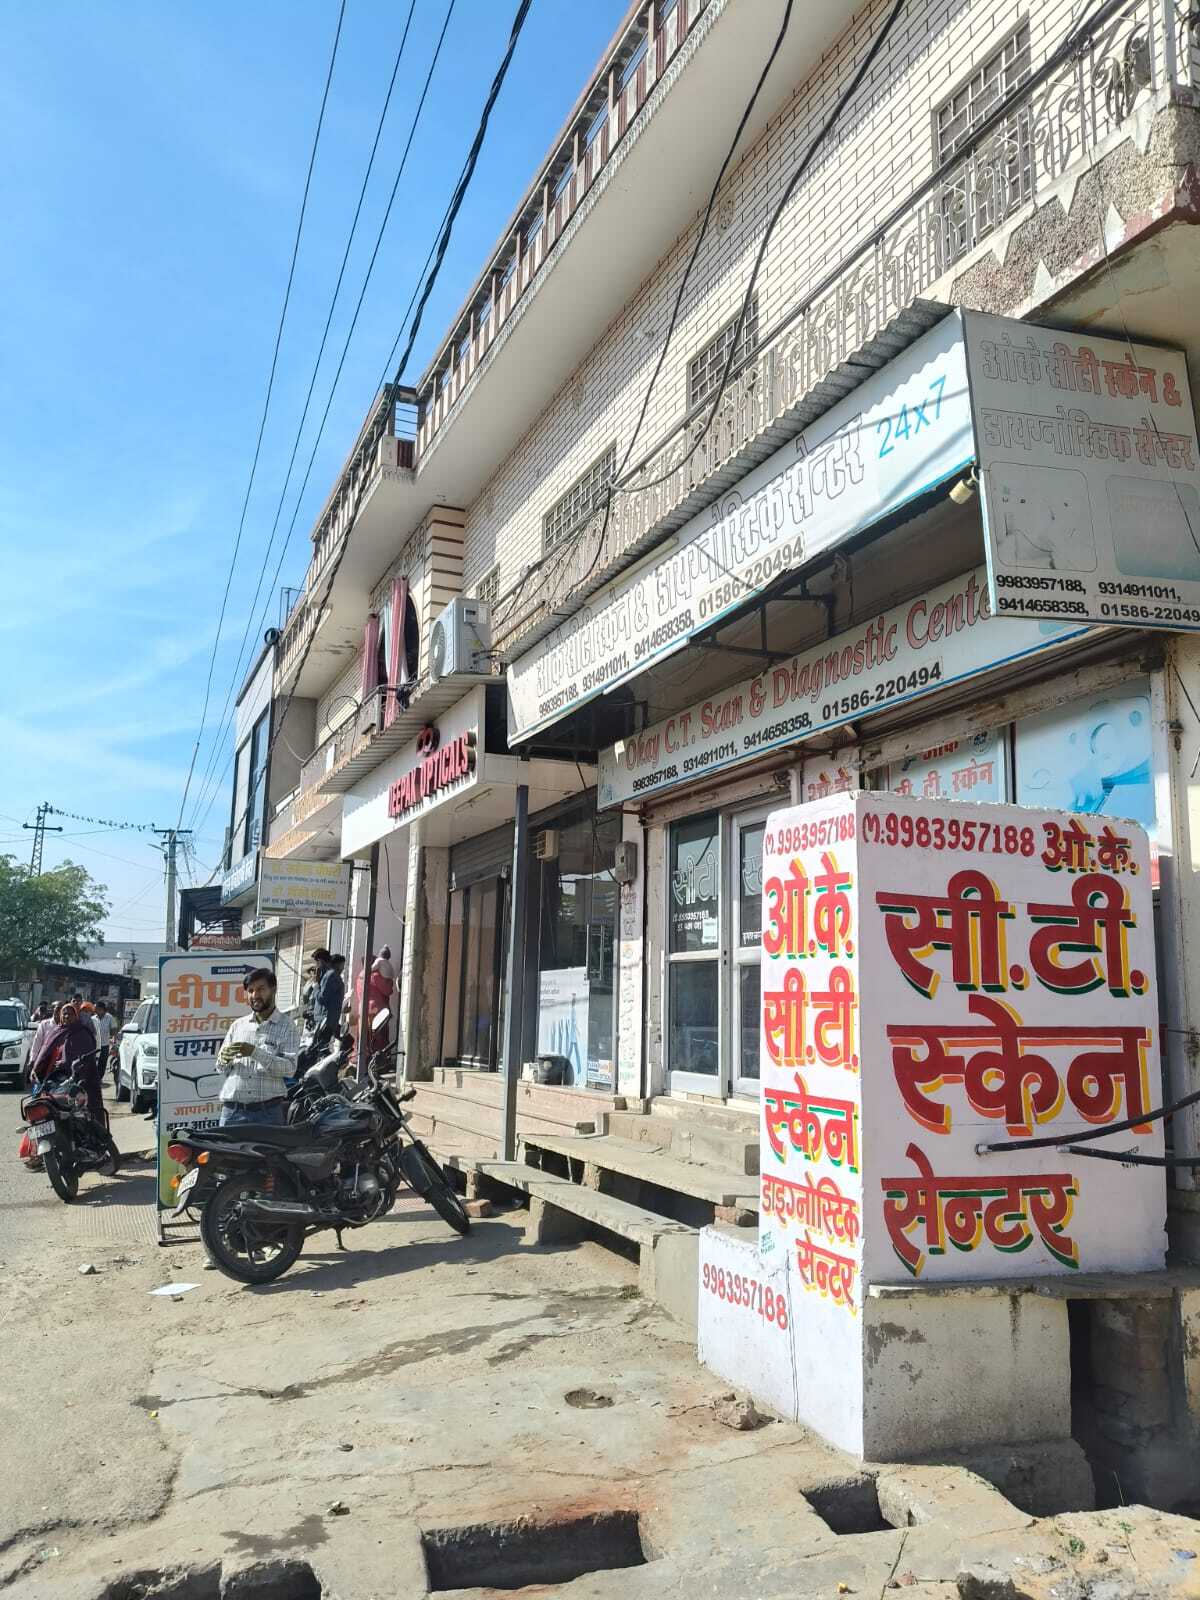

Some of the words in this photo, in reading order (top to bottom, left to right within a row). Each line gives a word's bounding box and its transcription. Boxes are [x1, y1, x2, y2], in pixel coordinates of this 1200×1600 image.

[877, 375, 945, 458] 24x7
[1163, 372, 1182, 407] &
[699, 536, 804, 618] 01586-220494
[996, 574, 1086, 595] 9983957188,
[1098, 582, 1181, 602] 9314911011,
[999, 597, 1089, 617] 9414658358,
[1101, 603, 1200, 622] 01586-22049
[625, 730, 660, 771] Okay
[700, 695, 742, 738] Scan
[749, 680, 767, 718] &
[772, 615, 898, 709] Diagnostic
[906, 573, 992, 649] Cente
[683, 742, 738, 773] 9314911011,
[743, 711, 813, 752] 9414658358,
[822, 662, 941, 721] 01586-220494
[419, 731, 477, 797] OPTICALS
[876, 869, 1149, 999] सी.टी.
[887, 994, 1153, 1136] स्केन
[764, 1072, 858, 1174] स्केन
[881, 1142, 1079, 1279] सेन्टर
[702, 1262, 789, 1331] 9983957188
[795, 1229, 857, 1316] सेन्टर
